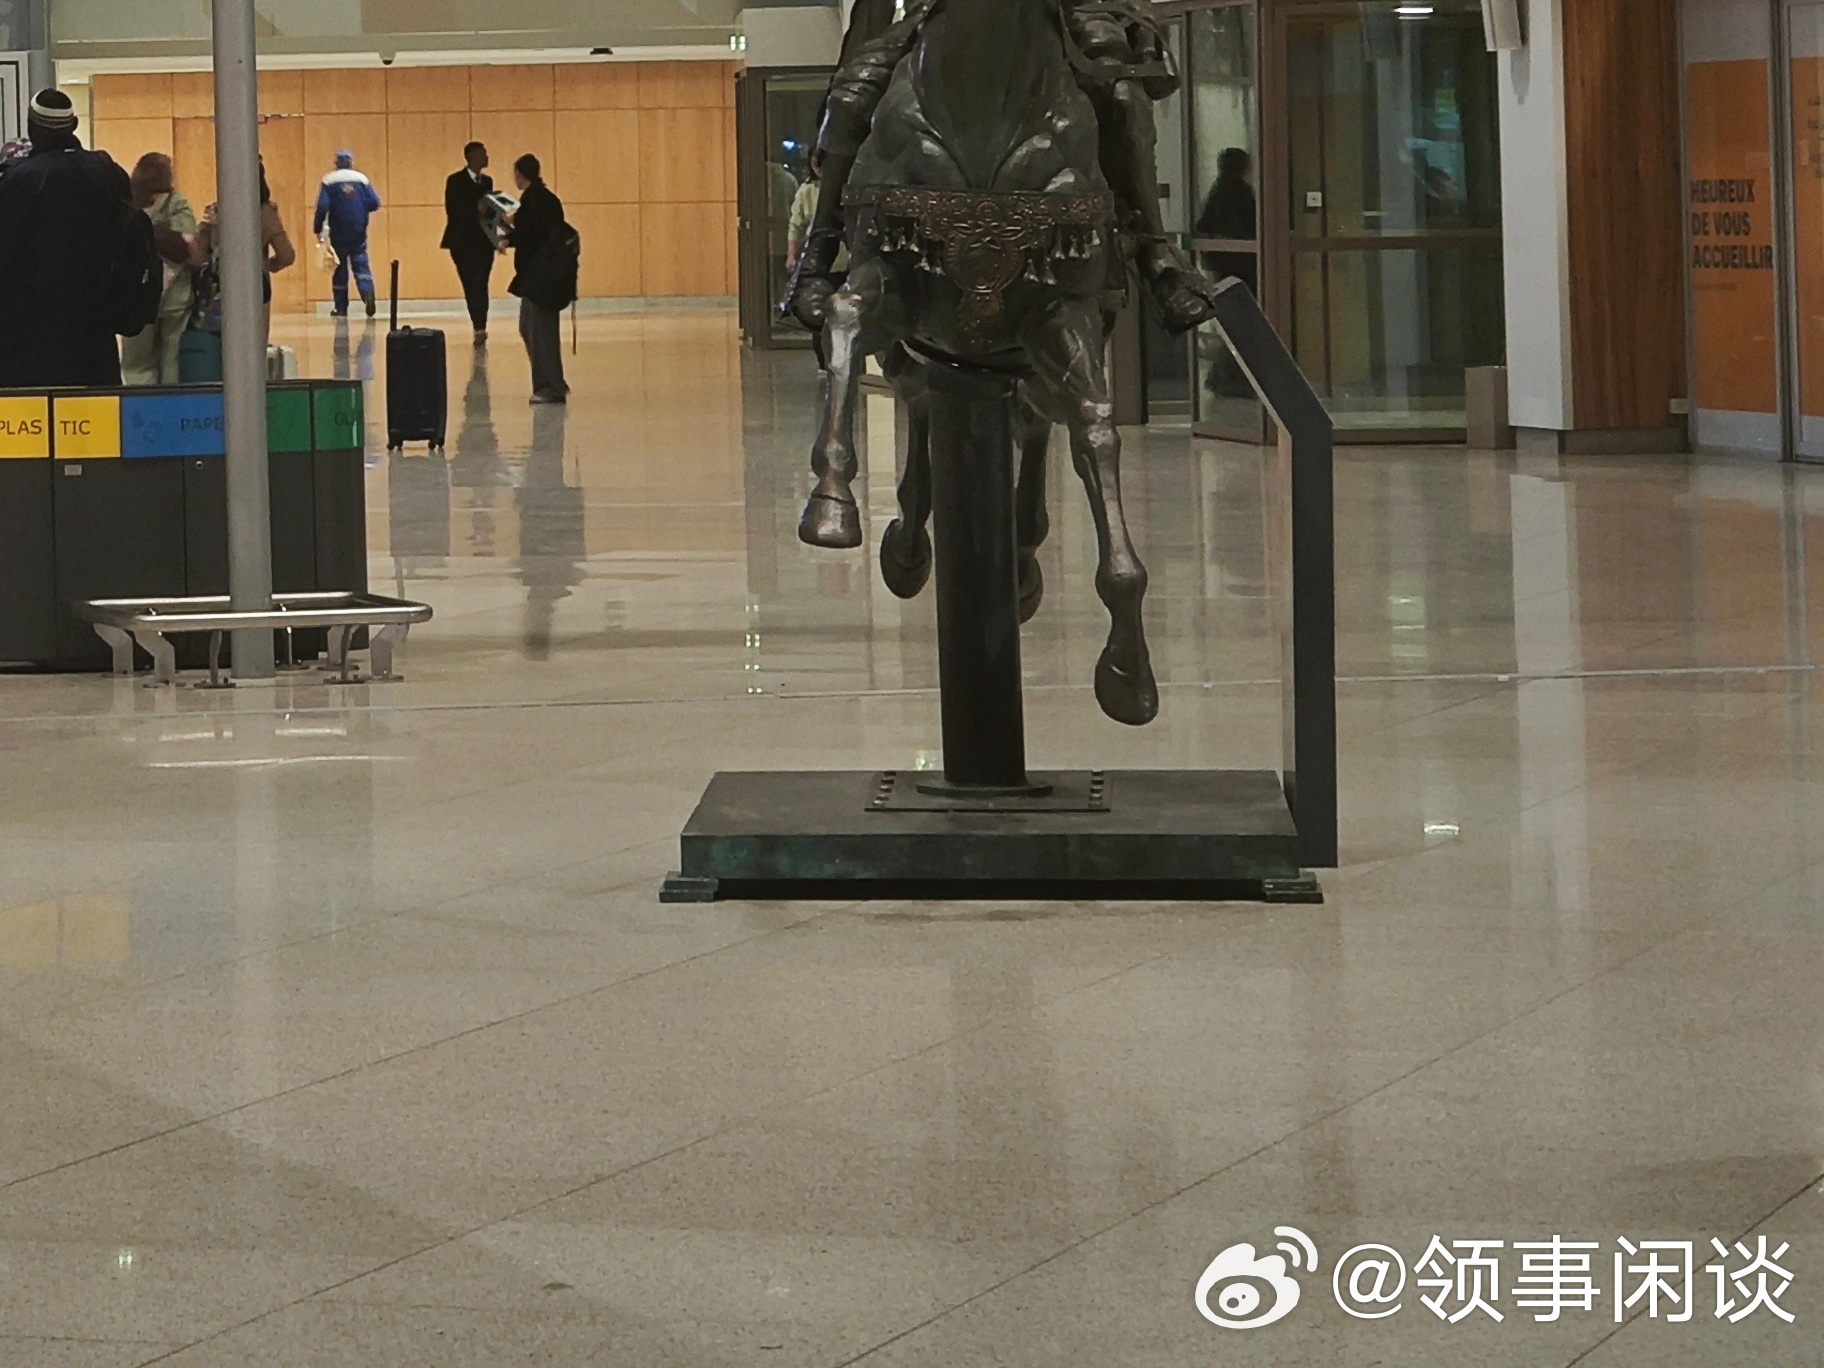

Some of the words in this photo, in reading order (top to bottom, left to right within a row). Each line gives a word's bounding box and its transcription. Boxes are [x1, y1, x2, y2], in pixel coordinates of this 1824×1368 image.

[1690, 179, 1755, 203] HEUREUX
[1691, 212, 1709, 236] DE
[1713, 212, 1751, 236] VOUS
[1692, 245, 1773, 269] ACCUEILLIR
